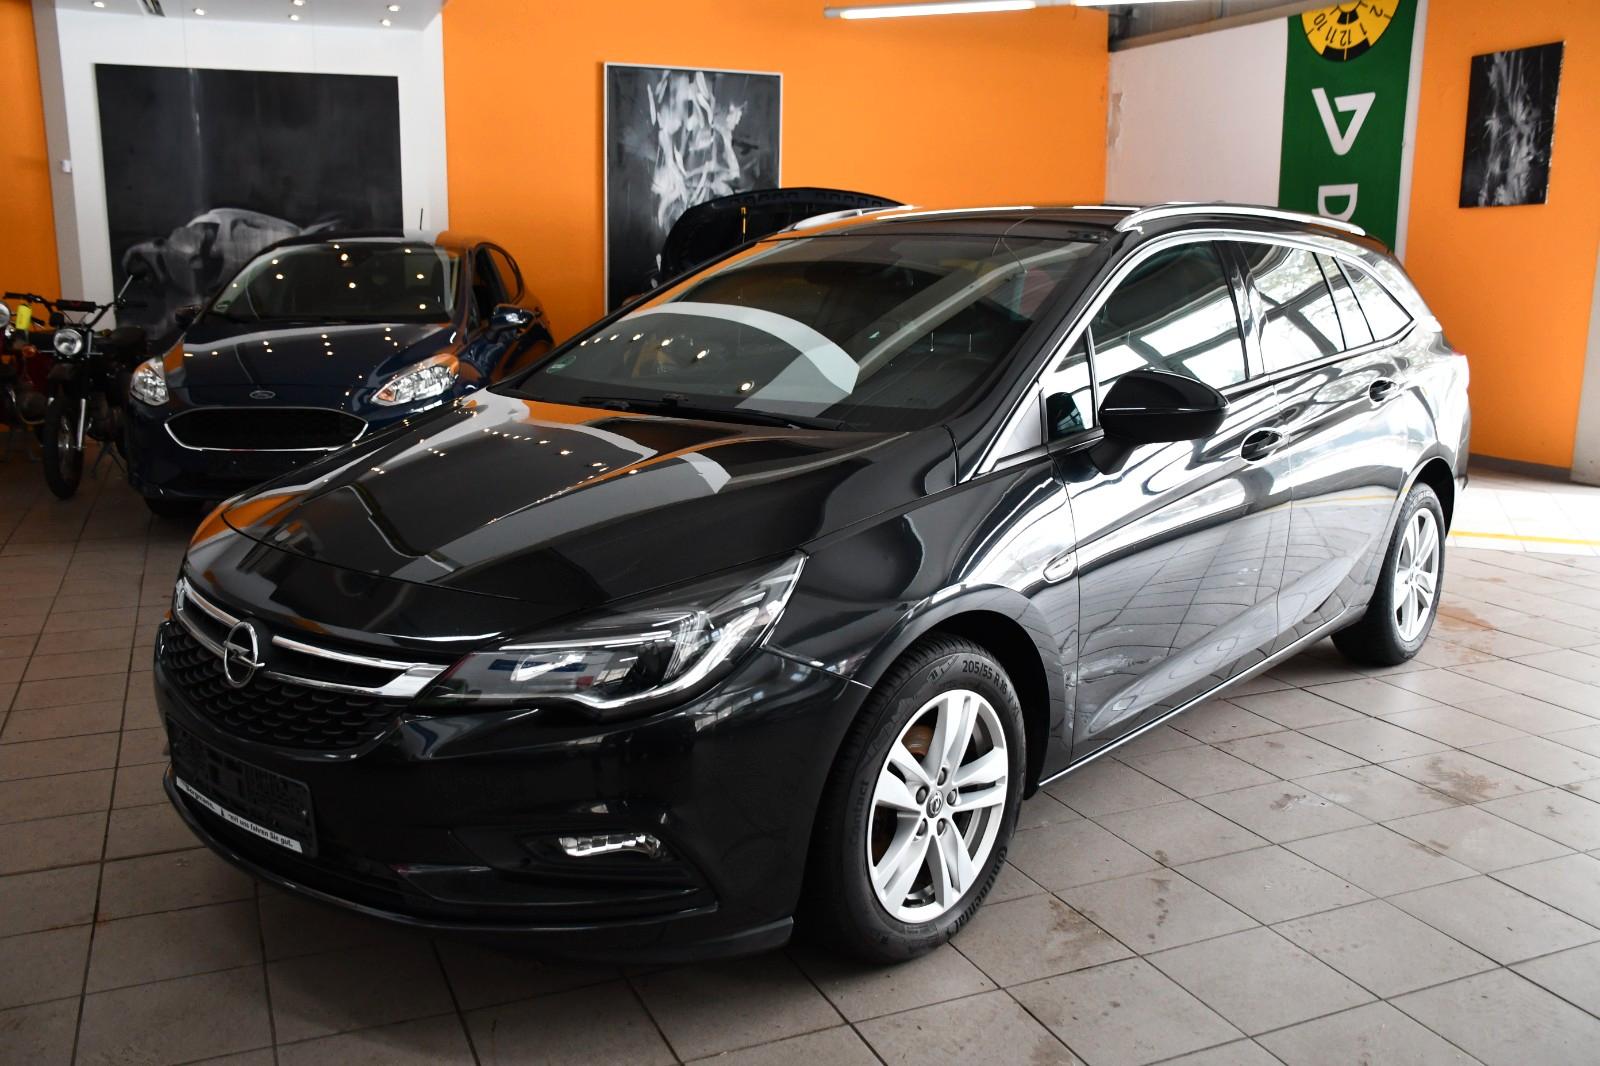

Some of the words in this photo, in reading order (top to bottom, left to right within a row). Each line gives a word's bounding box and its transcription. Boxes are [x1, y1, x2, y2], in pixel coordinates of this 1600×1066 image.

[1313, 12, 1328, 31] 10
[1325, 26, 1337, 44] 11
[1339, 29, 1353, 47] 12
[962, 660, 993, 679] 205/55
[993, 672, 1000, 686] R
[999, 679, 1008, 693] 16
